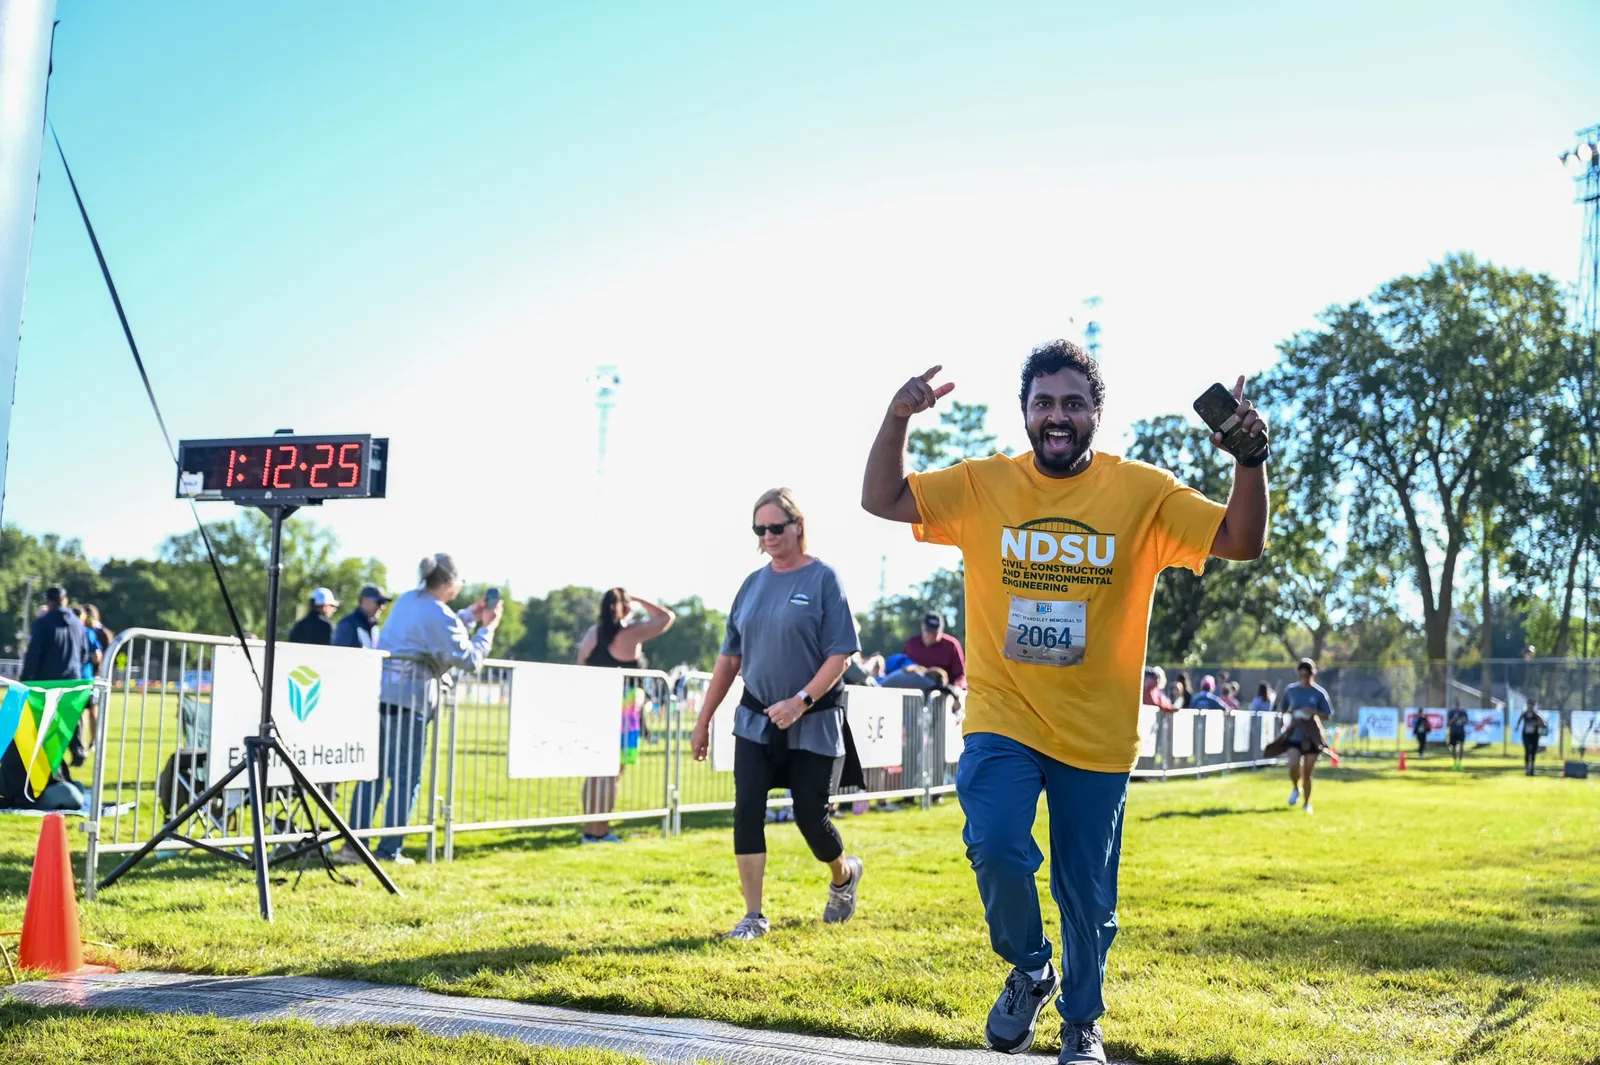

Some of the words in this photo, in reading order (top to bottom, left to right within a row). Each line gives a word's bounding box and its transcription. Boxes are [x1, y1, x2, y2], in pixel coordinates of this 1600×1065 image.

[1001, 528, 1115, 567] NDSU
[1002, 559, 1028, 571] CIVIL,
[1031, 563, 1113, 576] CONSTRUCTION
[1003, 568, 1020, 578] AND
[1024, 571, 1112, 585] ENVIRONMENTAL
[1002, 576, 1068, 593] ENGINEERING
[1016, 623, 1072, 649] 2064
[312, 742, 365, 766] Health
